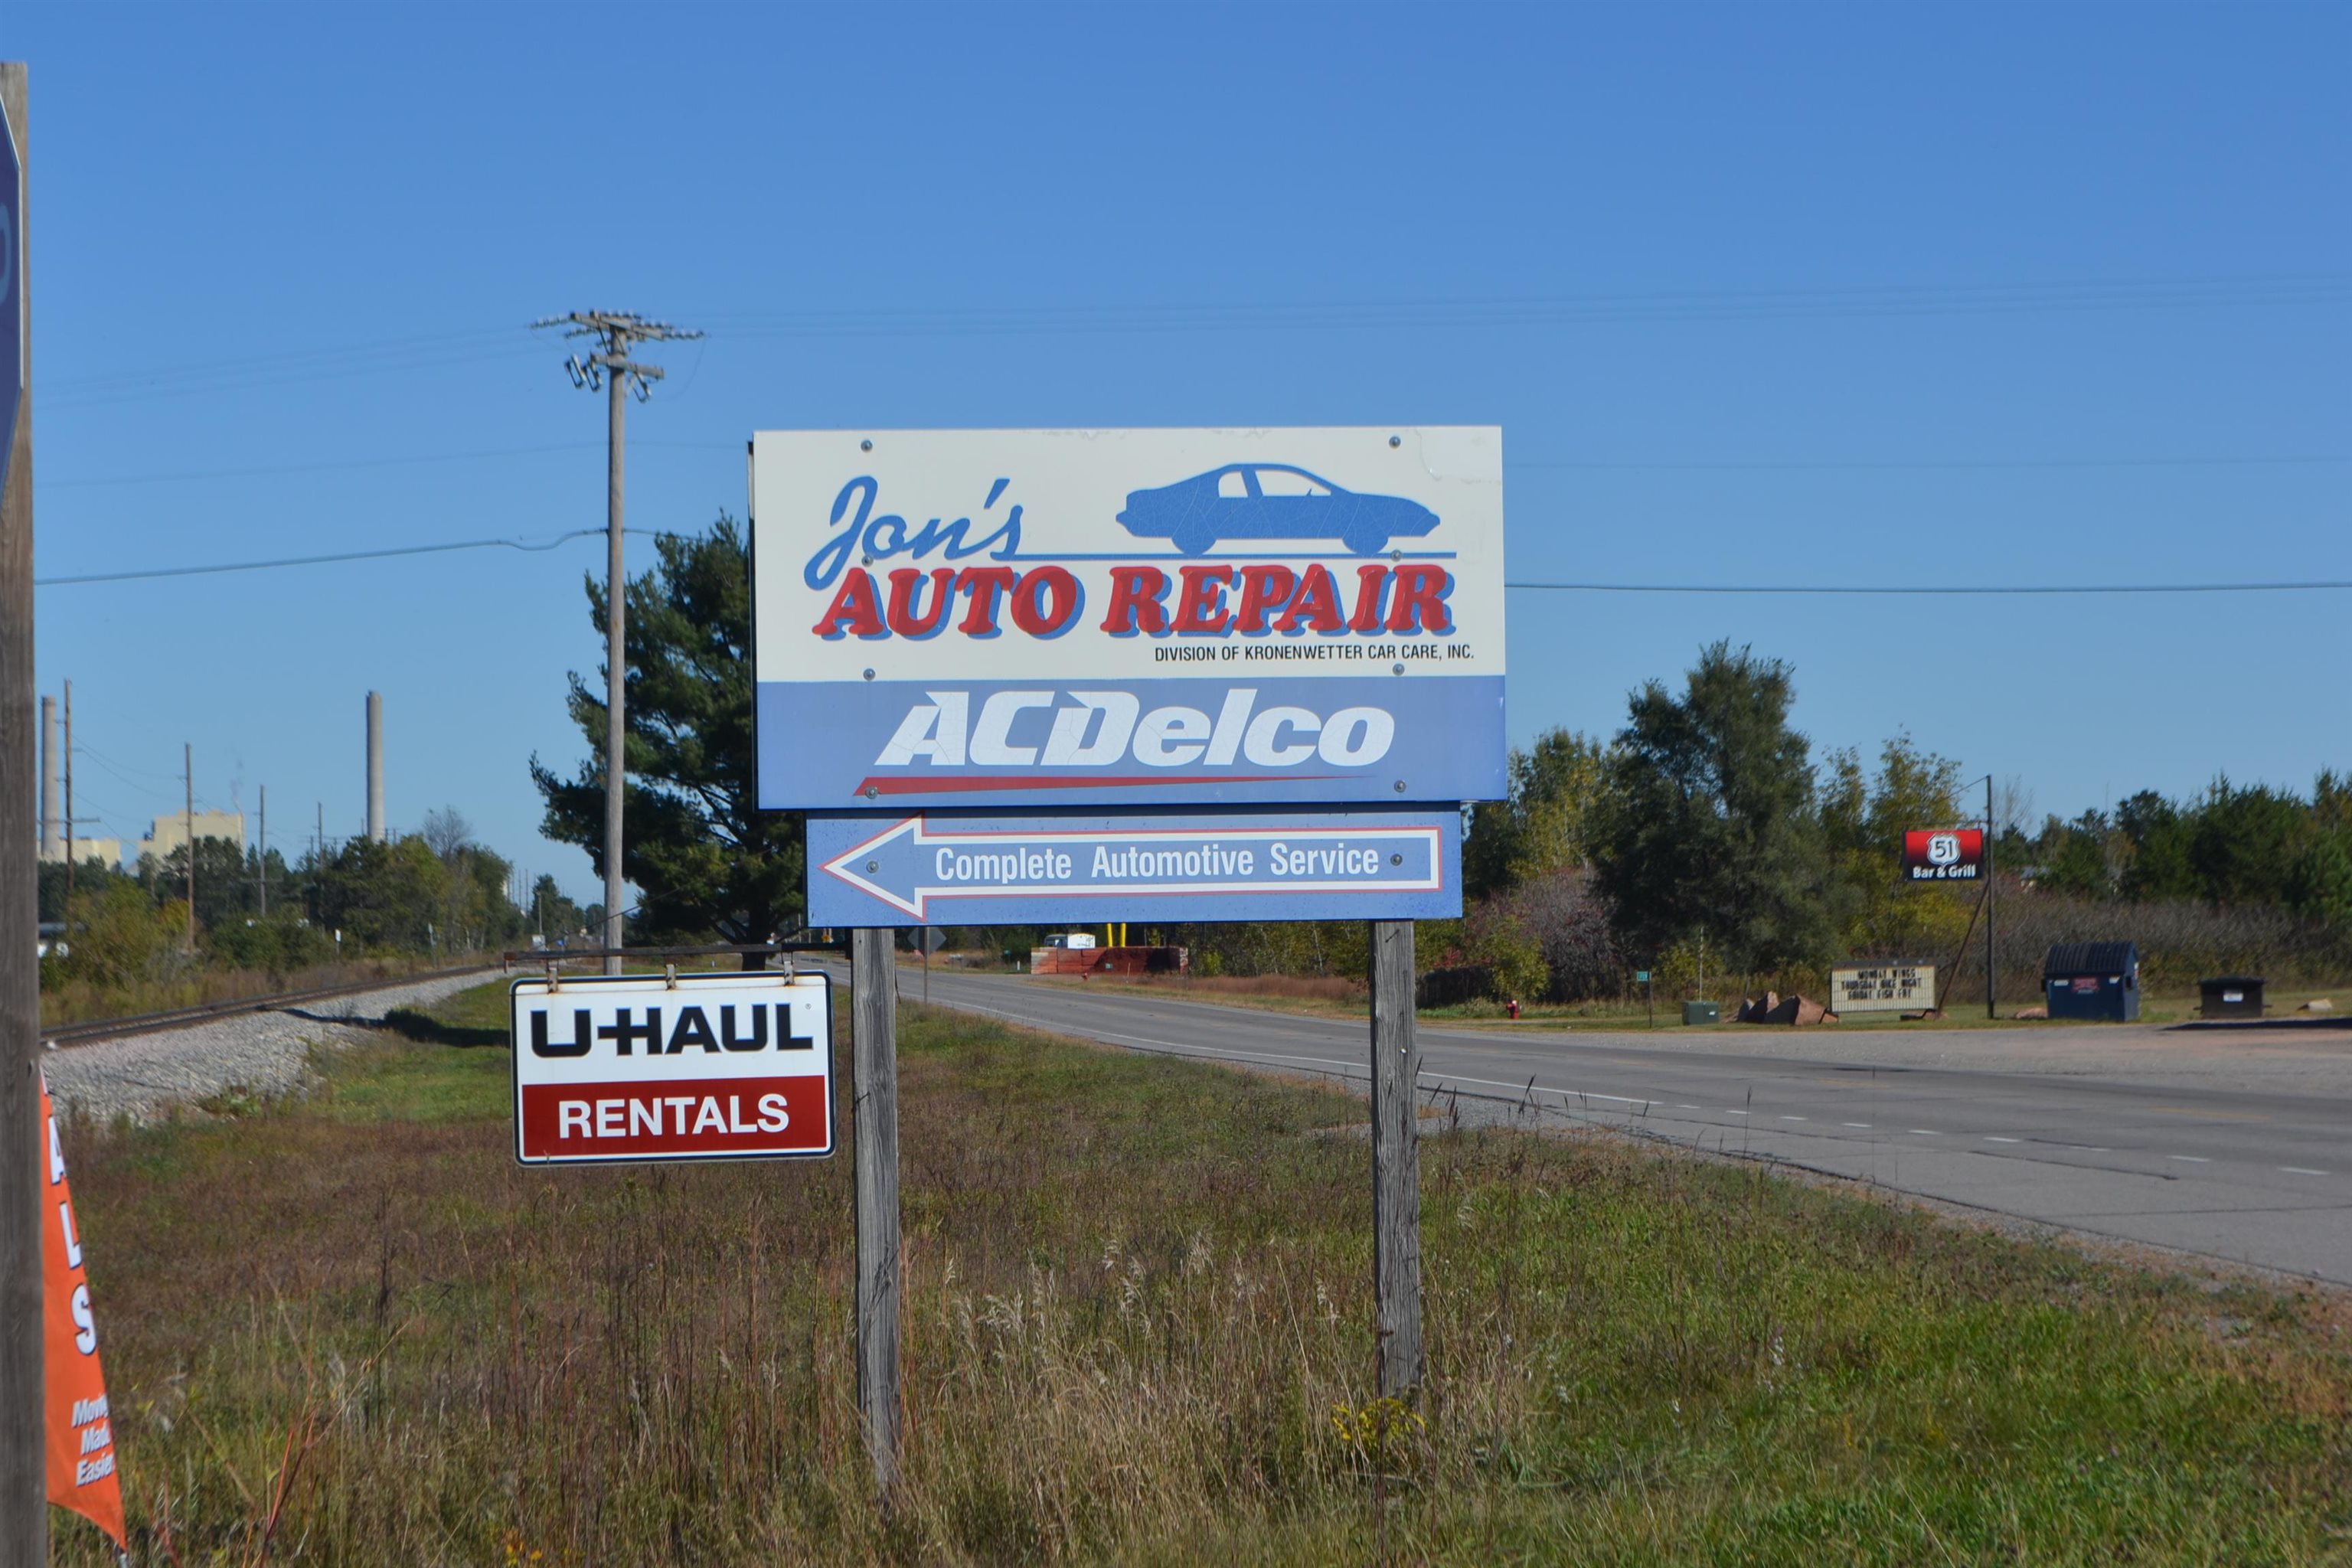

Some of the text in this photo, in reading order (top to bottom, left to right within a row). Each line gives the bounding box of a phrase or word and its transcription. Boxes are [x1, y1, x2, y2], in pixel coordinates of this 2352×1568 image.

[804, 475, 1024, 590] Jon's
[812, 564, 1457, 640] AUTO REPAIR
[1155, 644, 1475, 662] DIVISION OF KRONENWETTER CAR CARE, INC.
[874, 688, 1396, 767] ACDelco
[936, 842, 1379, 884] Complete Automotive Service
[1913, 864, 1976, 879] Bar & Grill
[1935, 840, 1953, 858] 51
[530, 1002, 813, 1058] U-HAUL
[559, 1093, 789, 1139] RENTALS
